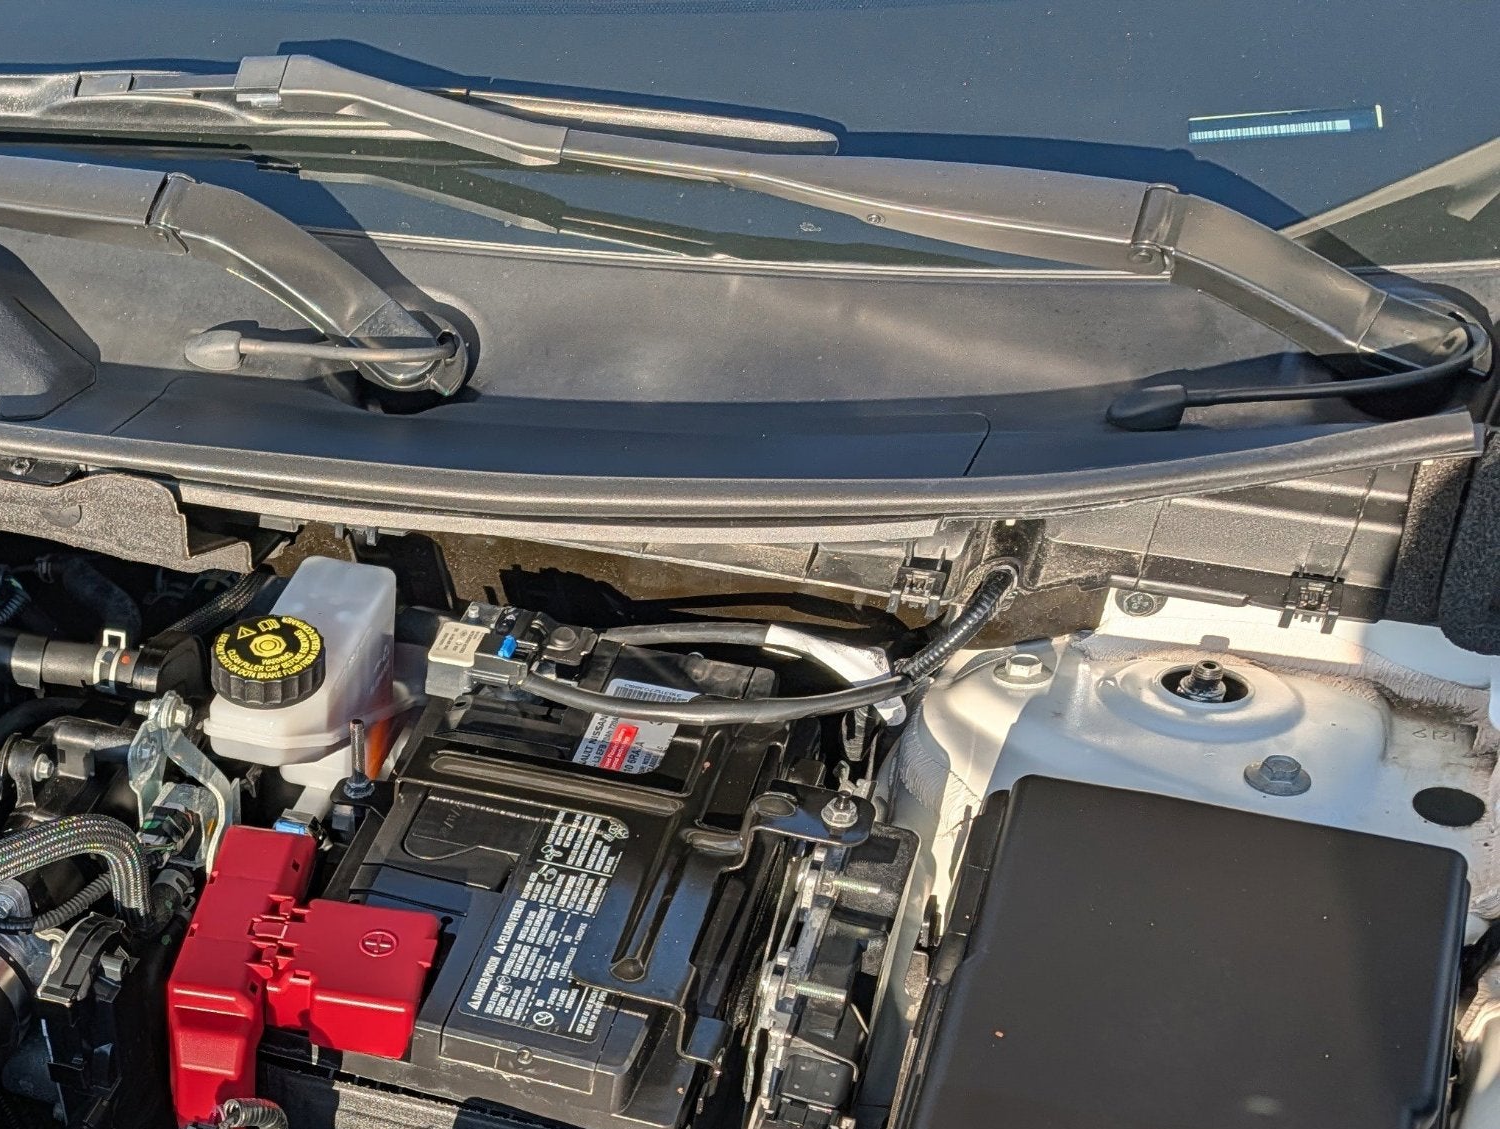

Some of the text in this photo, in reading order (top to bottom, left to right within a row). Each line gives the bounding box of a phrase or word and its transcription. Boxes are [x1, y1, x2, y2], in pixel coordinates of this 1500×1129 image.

[227, 649, 243, 667] CLEAN
[242, 660, 264, 672] FILLER
[281, 652, 307, 668] BEFORE
[261, 651, 293, 665] WARNING
[284, 666, 304, 675] FLUID
[301, 655, 317, 667] FROM
[588, 715, 609, 744] NISSAN
[497, 899, 527, 946] PELIGRO/VENENO
[563, 935, 573, 943] NO
[472, 955, 502, 1001] DANGER/POISON
[535, 999, 545, 1007] NO
[556, 990, 569, 1007] FLAMES
